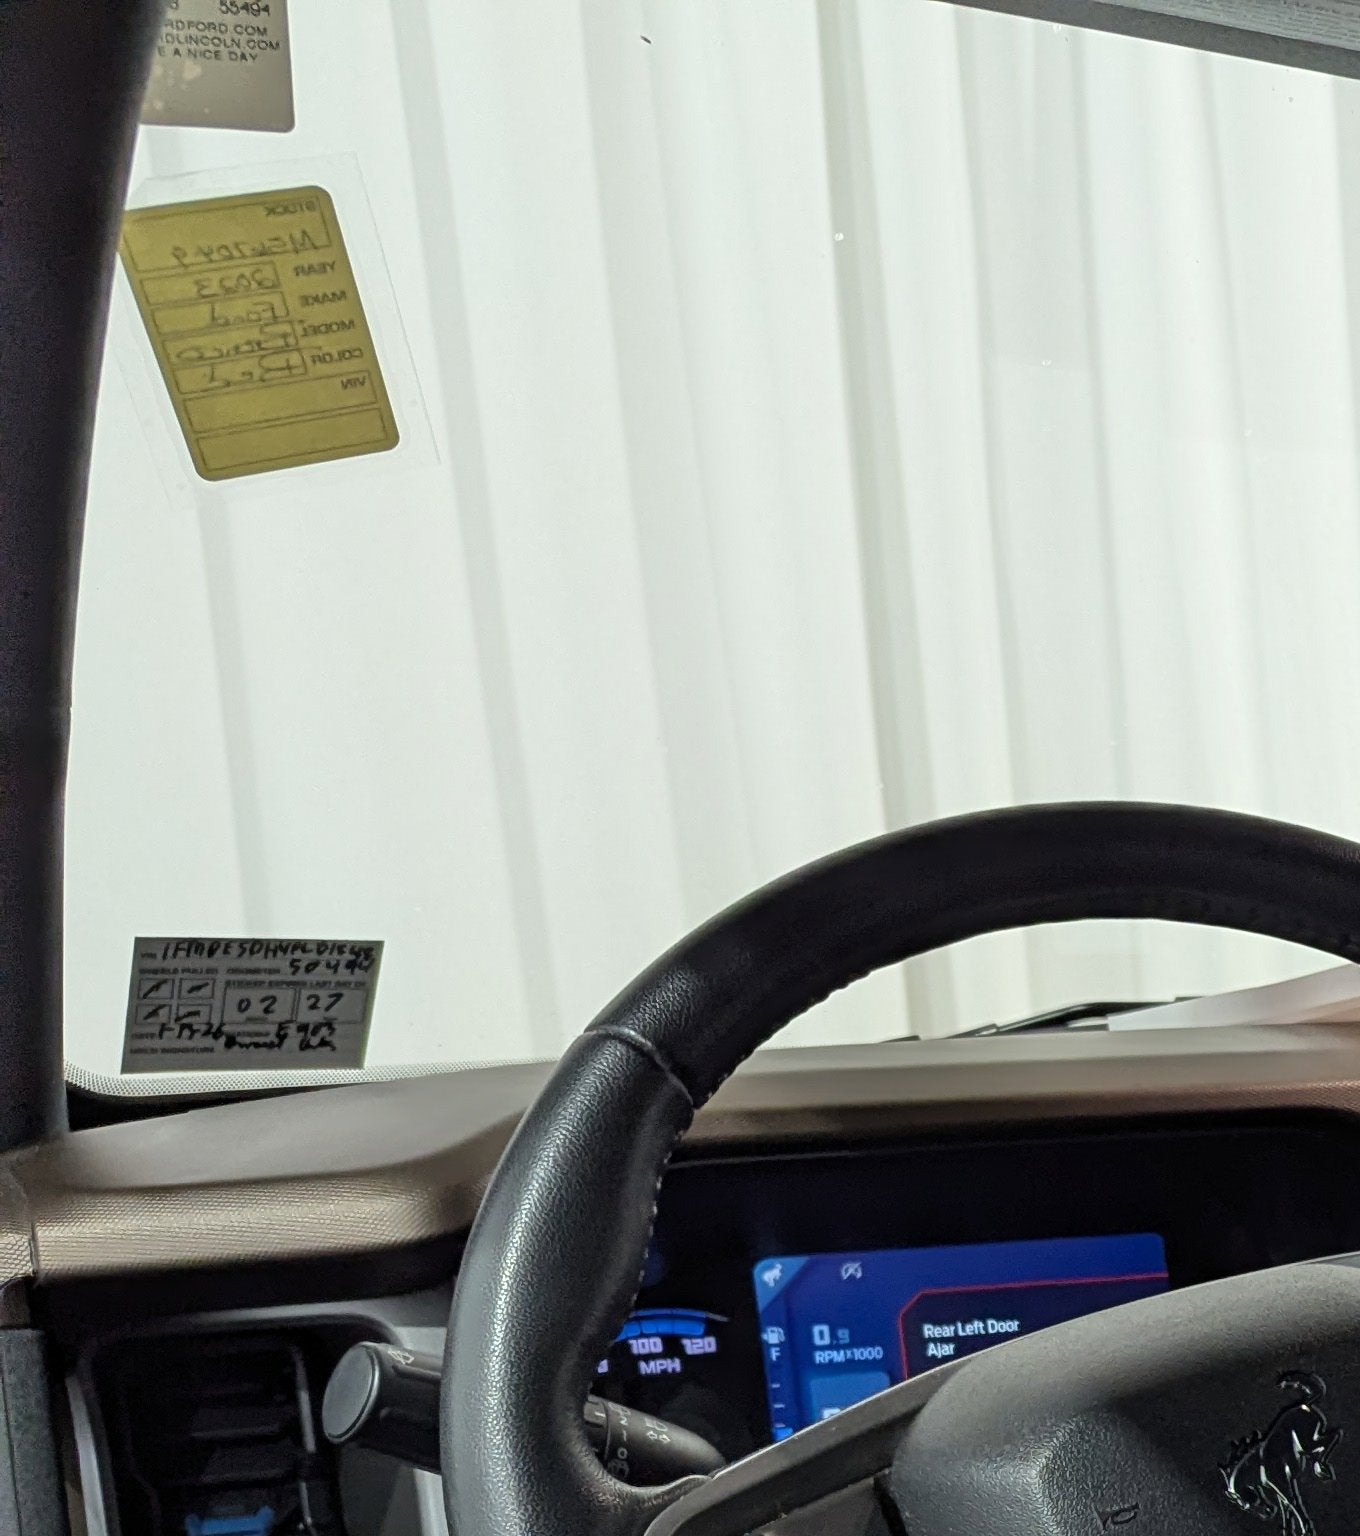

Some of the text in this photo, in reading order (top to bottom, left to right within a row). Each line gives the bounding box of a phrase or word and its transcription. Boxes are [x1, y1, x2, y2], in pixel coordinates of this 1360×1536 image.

[187, 48, 223, 61] NICE
[228, 50, 258, 63] DAY
[236, 992, 344, 1015] 02 27
[922, 1319, 1020, 1338] Rear Left Door
[628, 1336, 718, 1356] 100 120
[771, 1347, 781, 1361] F
[926, 1341, 956, 1359] Ajar
[639, 1358, 682, 1376] MPH
